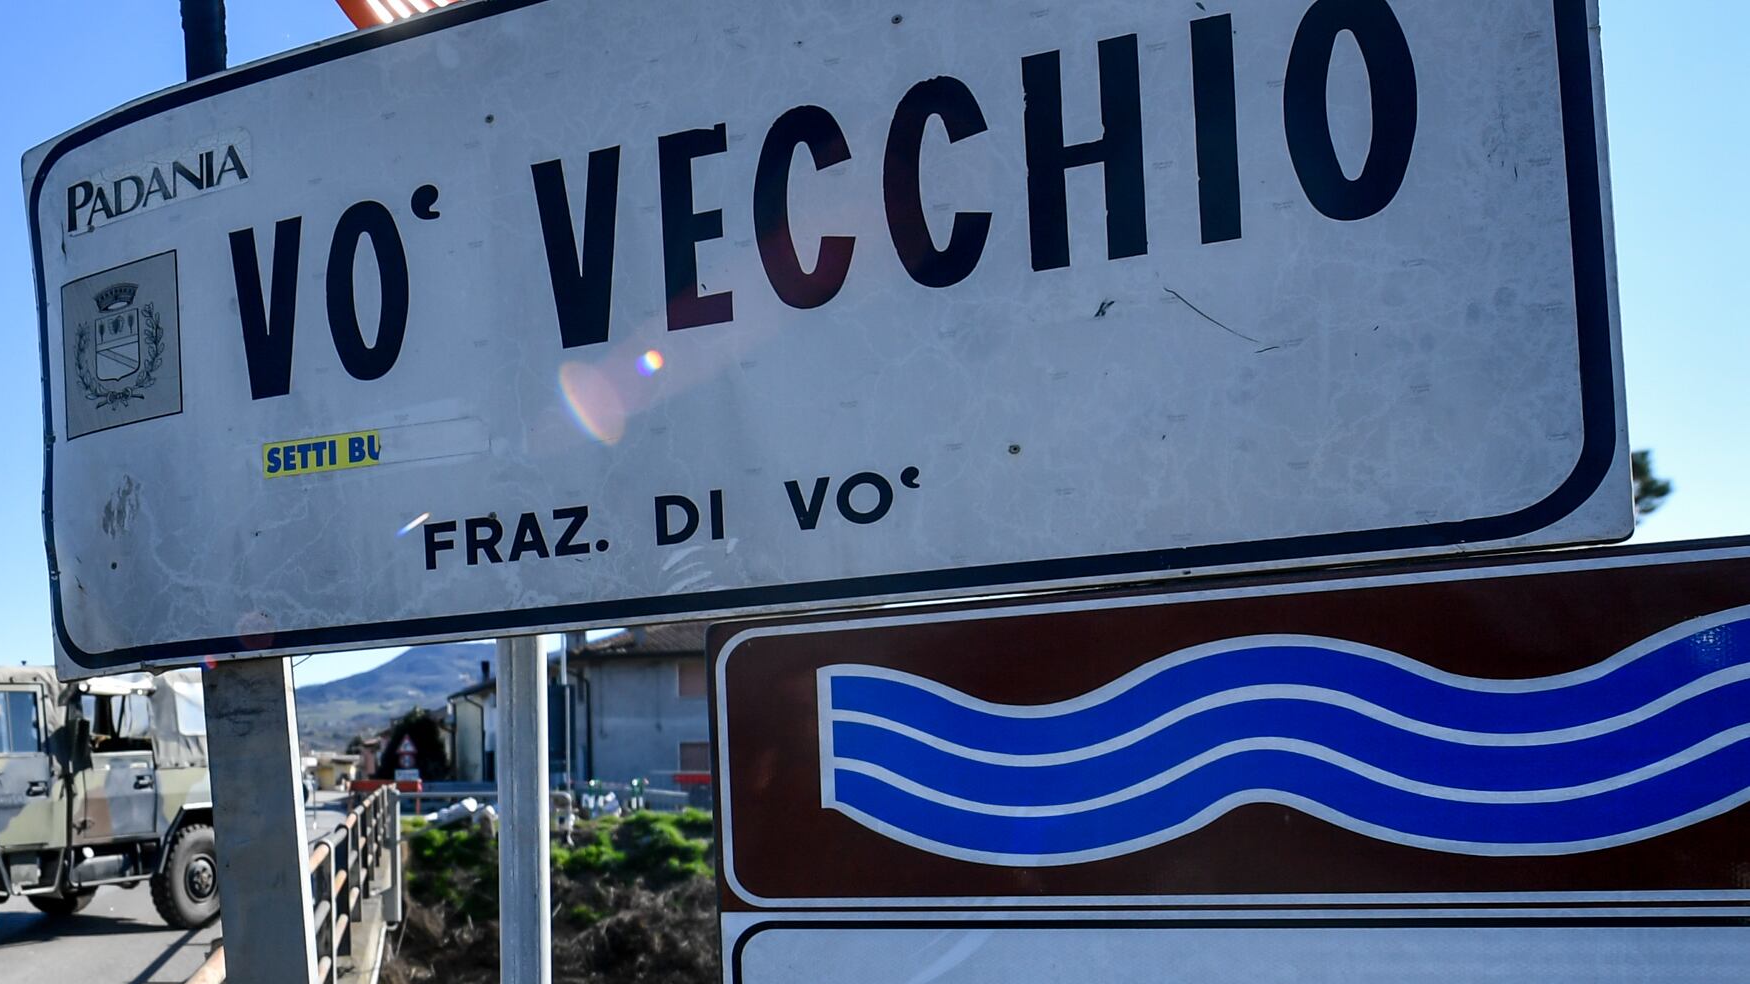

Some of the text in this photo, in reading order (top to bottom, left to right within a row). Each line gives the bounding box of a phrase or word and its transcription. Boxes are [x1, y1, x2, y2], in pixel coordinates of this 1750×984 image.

[67, 144, 250, 233] PADANIA
[531, 0, 1418, 349] VECCHIO
[266, 439, 337, 473] SETTI
[424, 505, 610, 571] FRAZ.
[655, 489, 725, 546] DI
